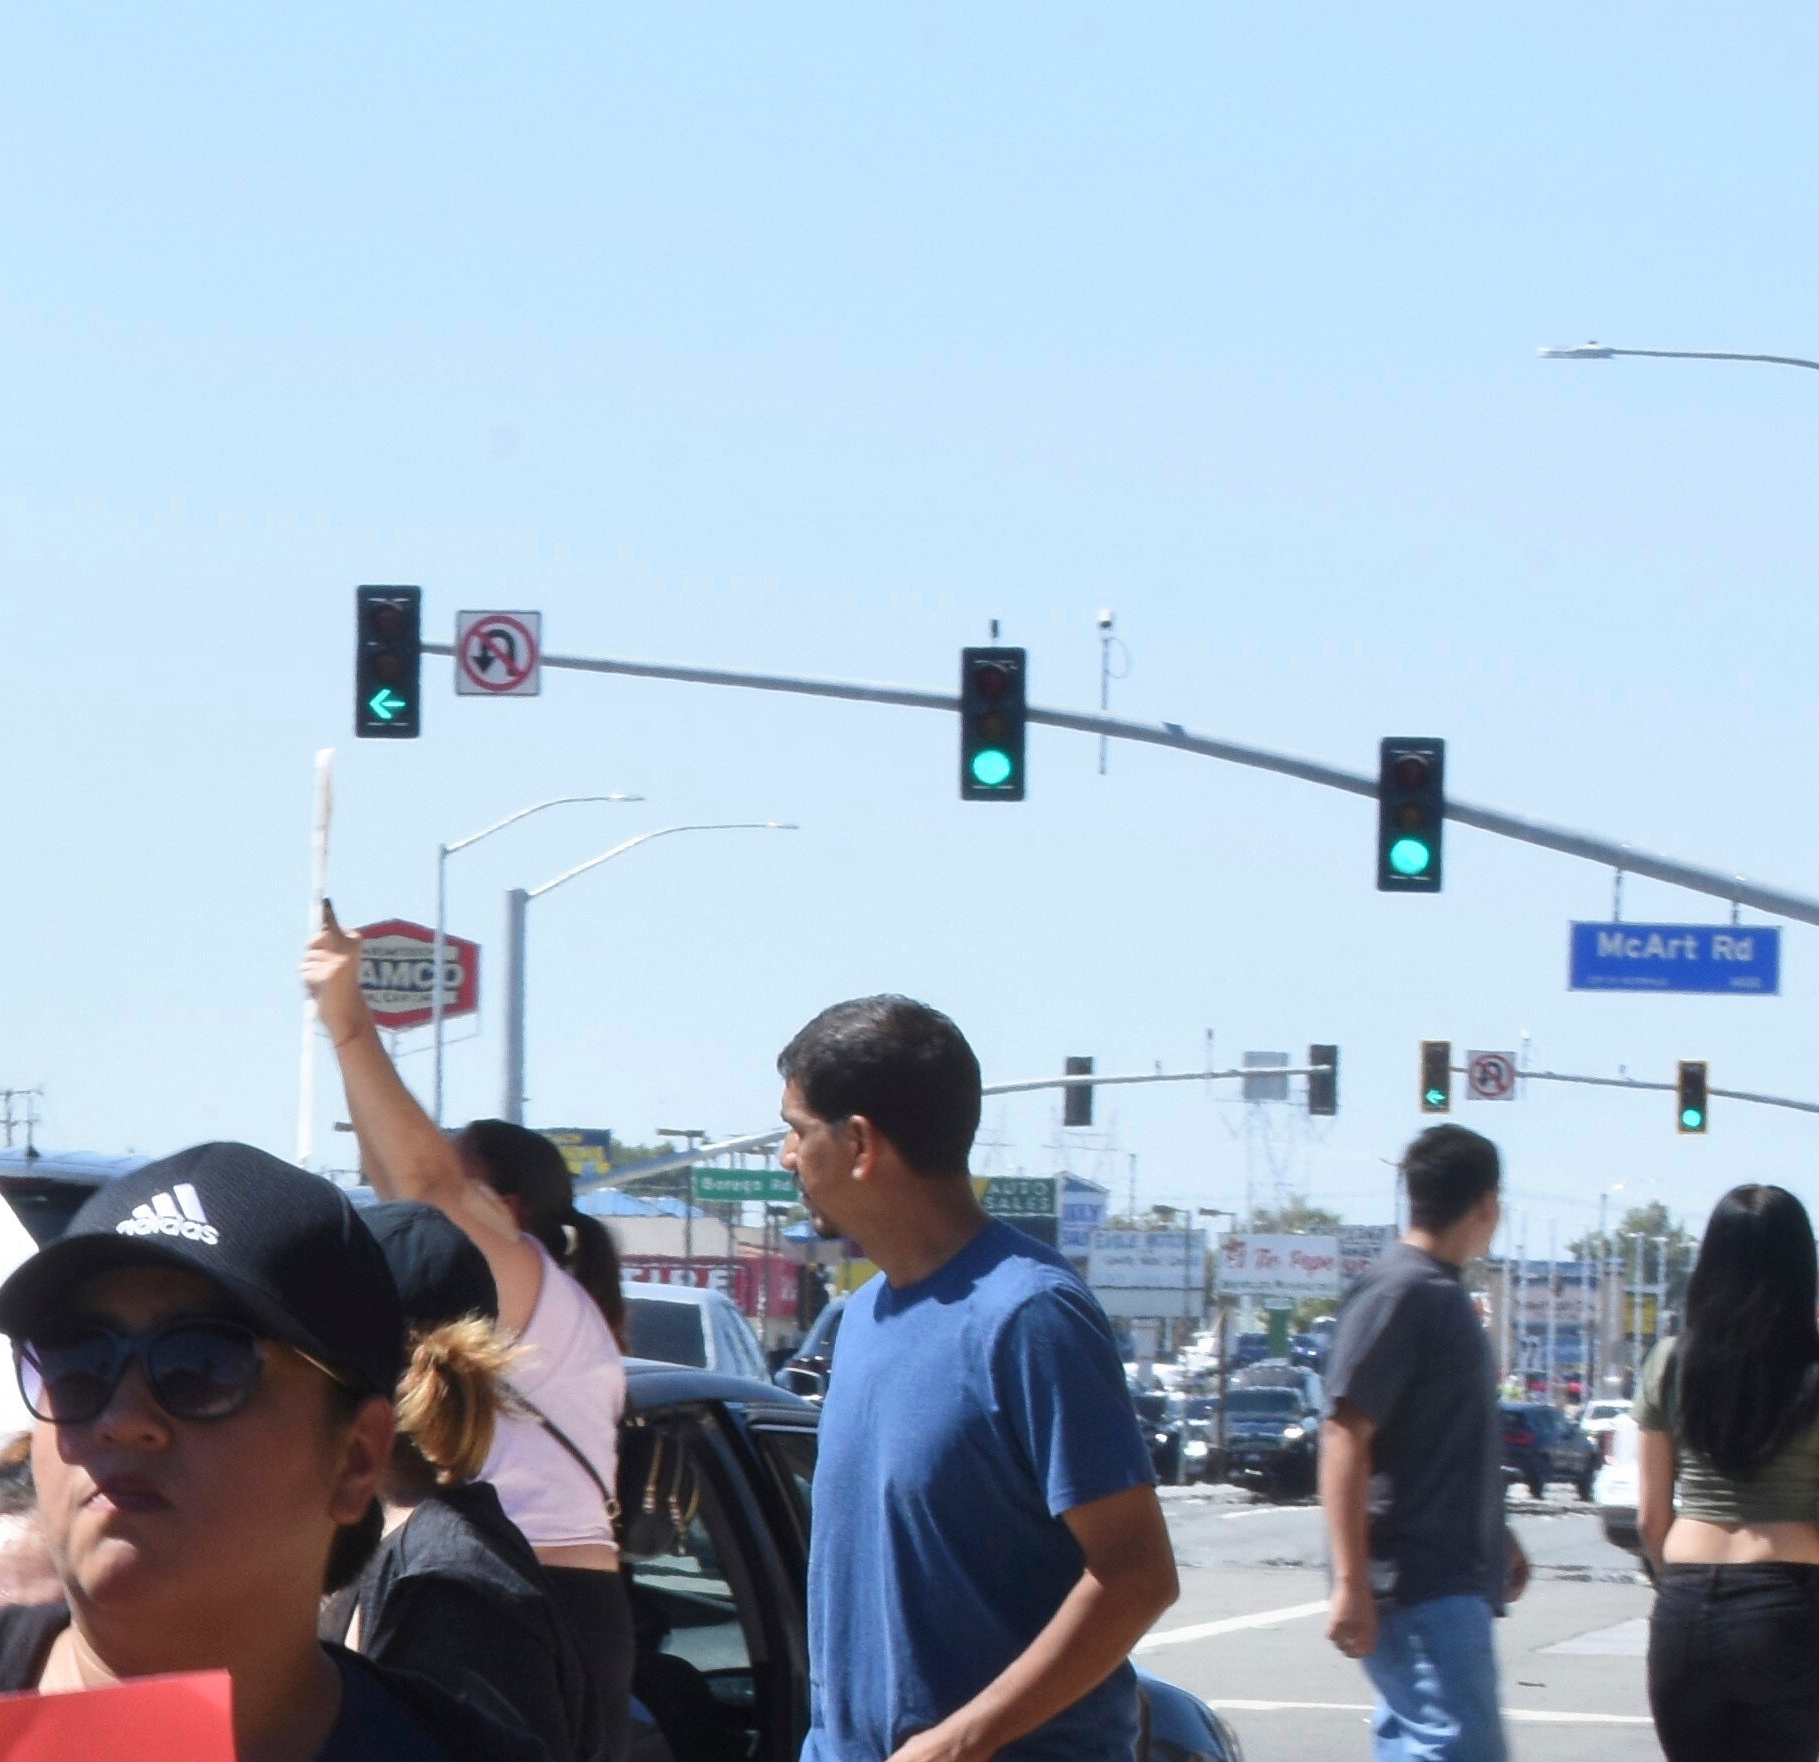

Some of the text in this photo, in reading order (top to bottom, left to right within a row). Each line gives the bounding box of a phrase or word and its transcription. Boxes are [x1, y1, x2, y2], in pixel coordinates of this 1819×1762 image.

[1597, 931, 1755, 961] McArt Rd
[357, 960, 466, 990] AMCO
[116, 1216, 219, 1245] adidas
